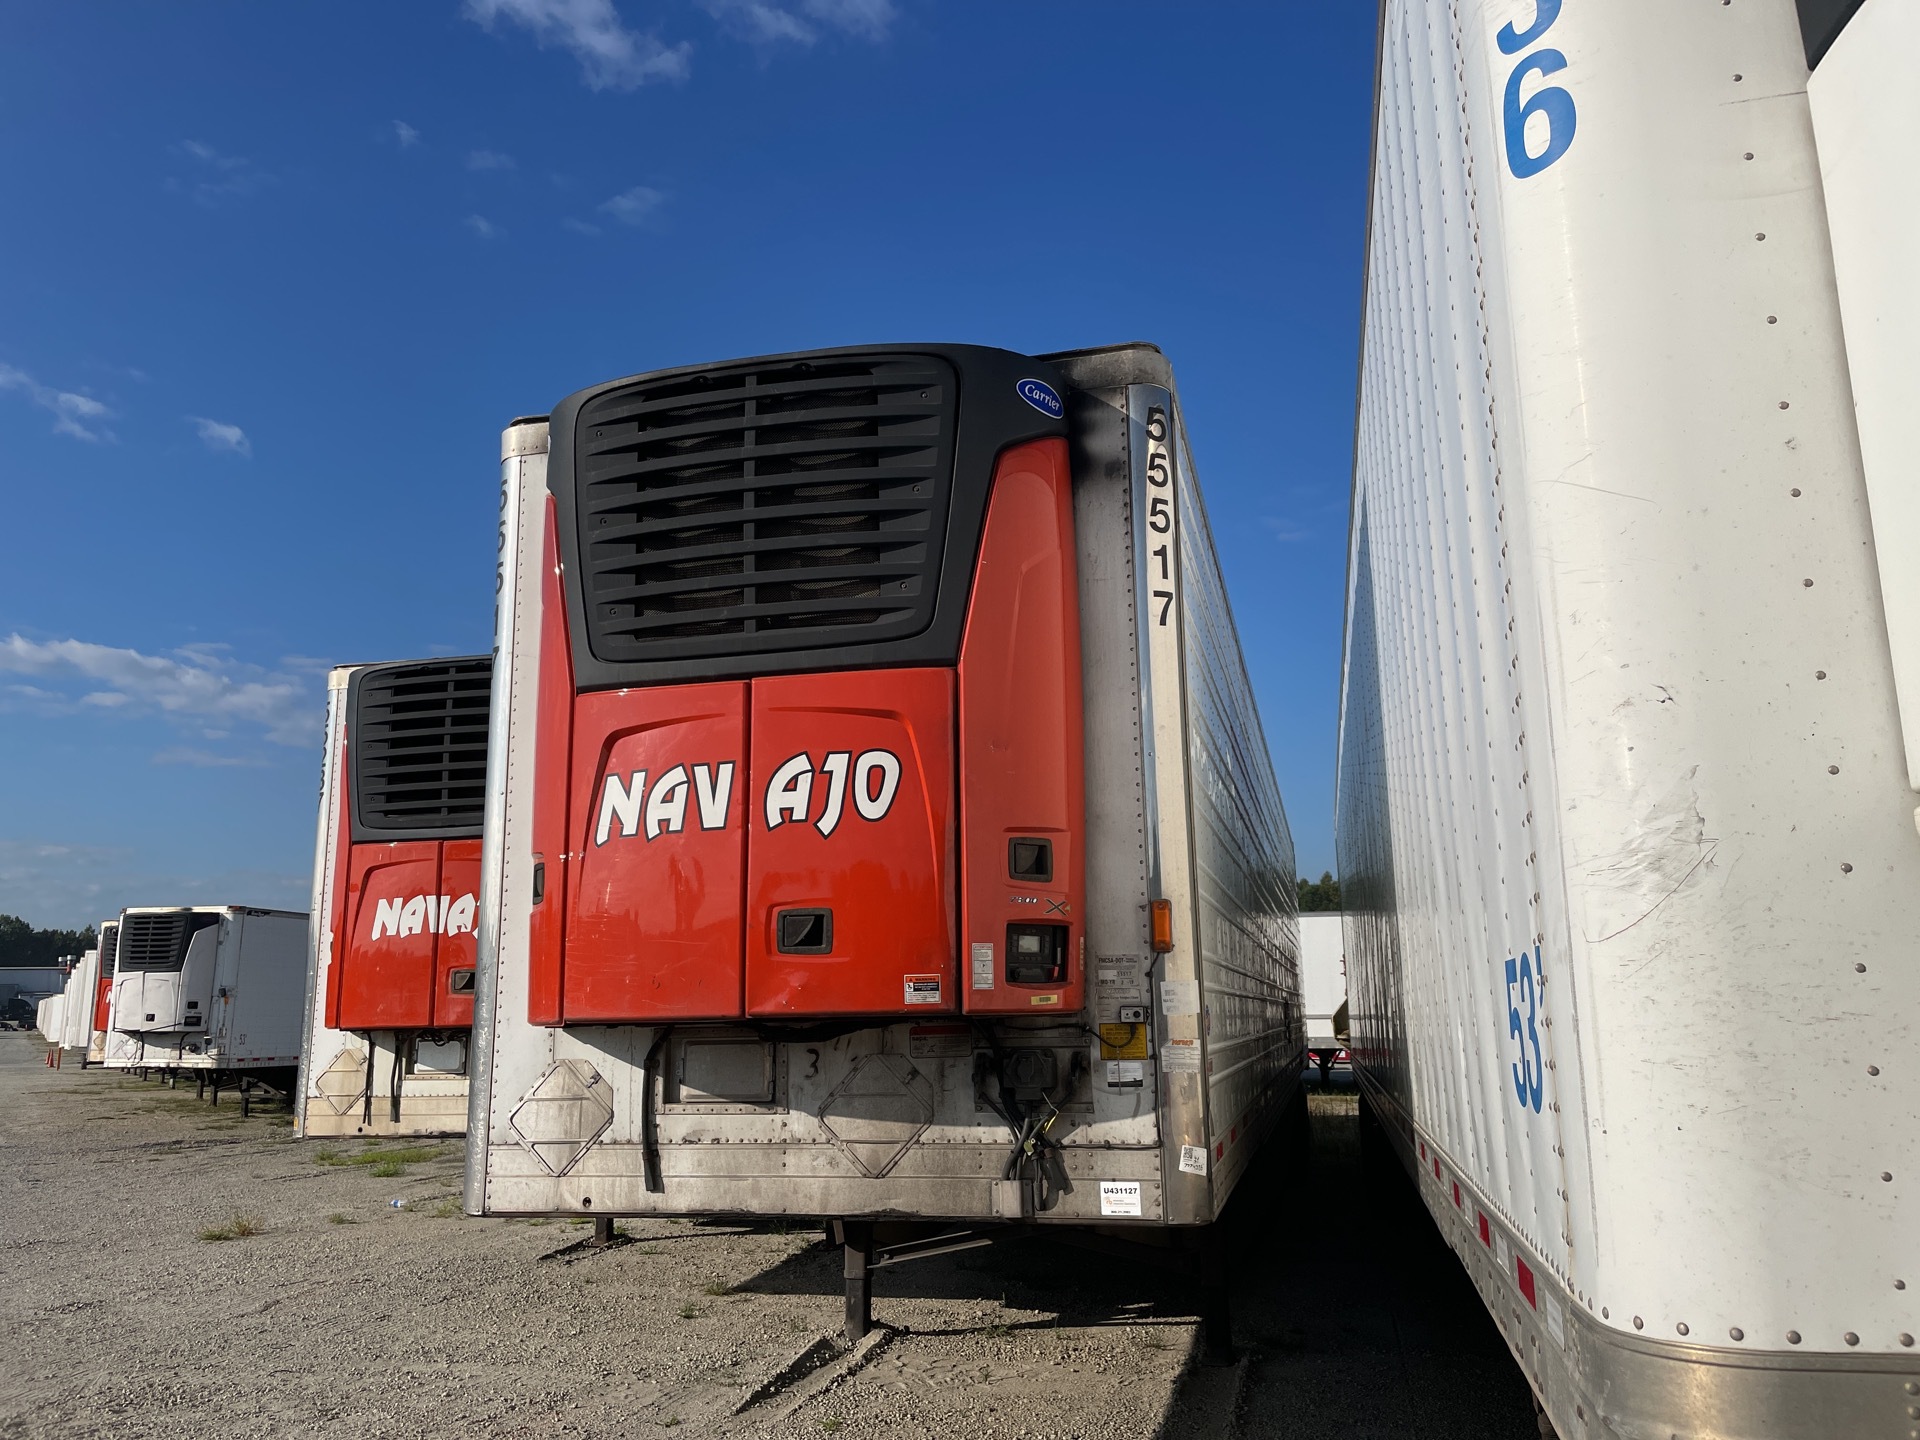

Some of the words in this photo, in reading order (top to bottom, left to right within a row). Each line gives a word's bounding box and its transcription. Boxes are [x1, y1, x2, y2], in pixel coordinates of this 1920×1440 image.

[1025, 384, 1060, 411] Carrier
[1146, 406, 1174, 626] 55517
[371, 893, 482, 942] NAVA
[1505, 945, 1543, 1114] 53'
[1103, 1187, 1138, 1195] U431127
